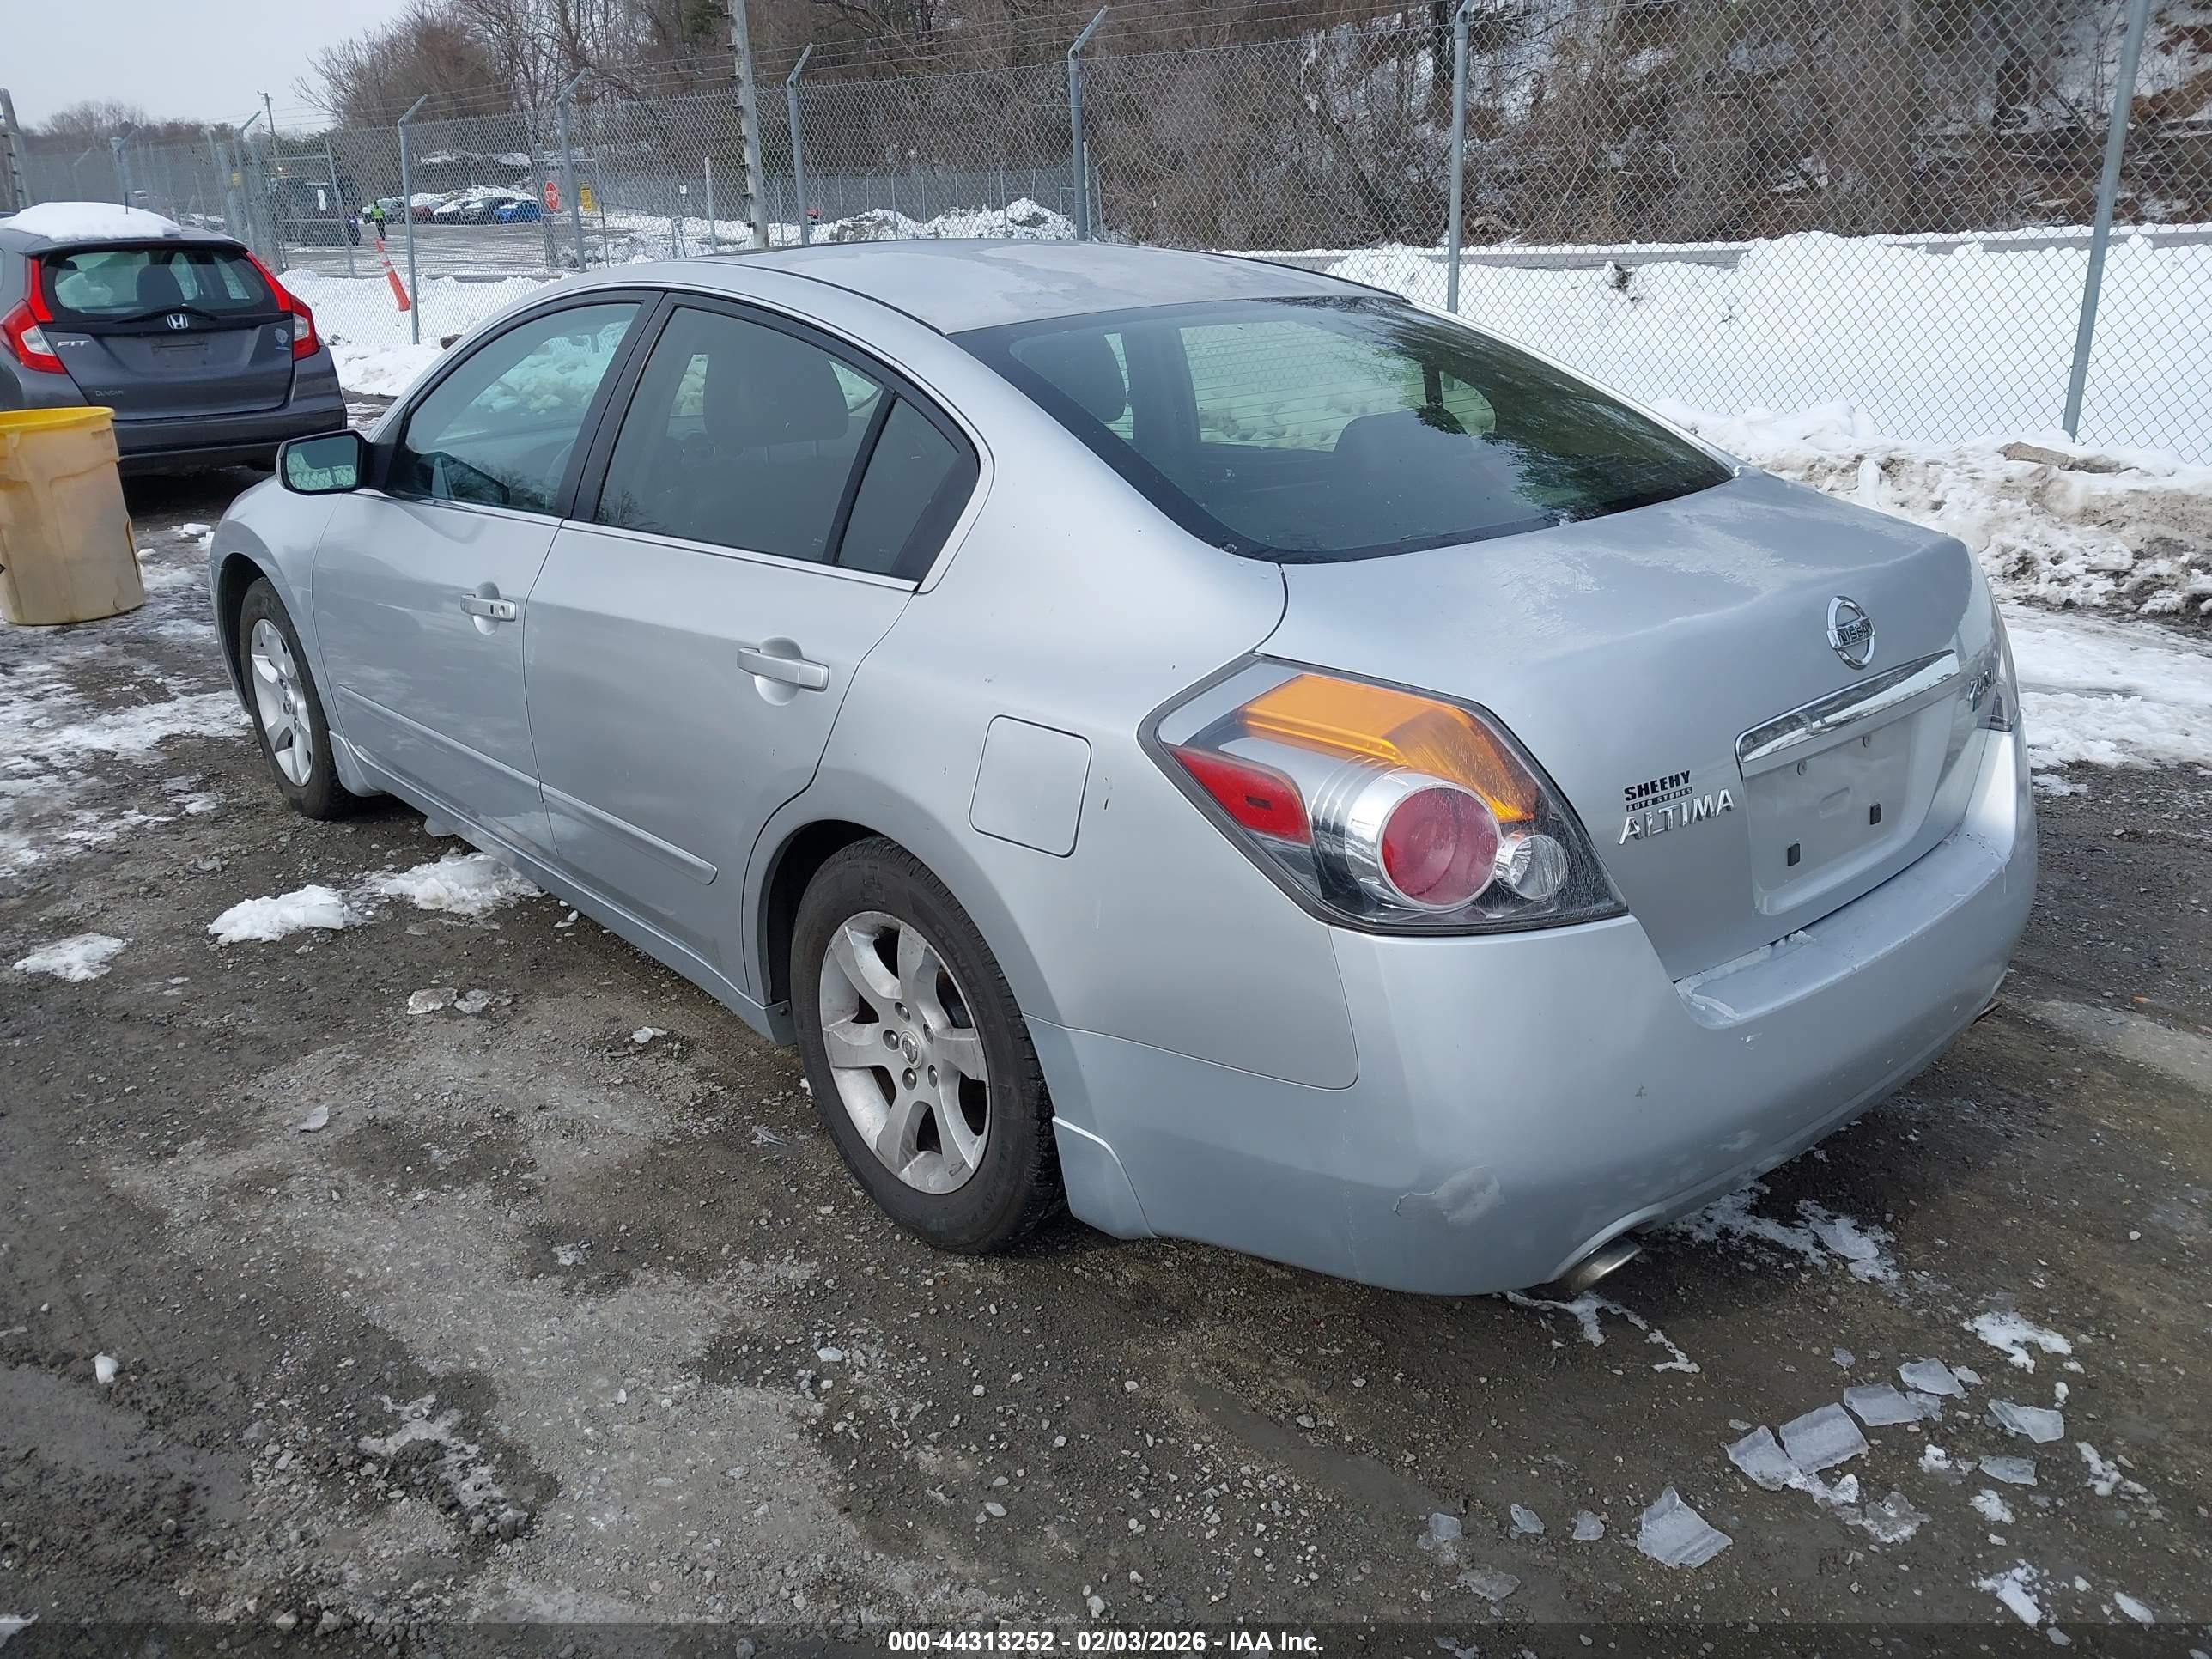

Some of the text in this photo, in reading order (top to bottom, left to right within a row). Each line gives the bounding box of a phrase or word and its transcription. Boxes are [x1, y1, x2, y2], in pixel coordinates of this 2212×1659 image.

[545, 190, 559, 203] STOP
[1838, 623, 1872, 646] NISSAN
[1624, 770, 1691, 801] SHEEHY
[1627, 787, 1693, 811] AUTO STORES
[1619, 788, 1735, 845] ALTIMA
